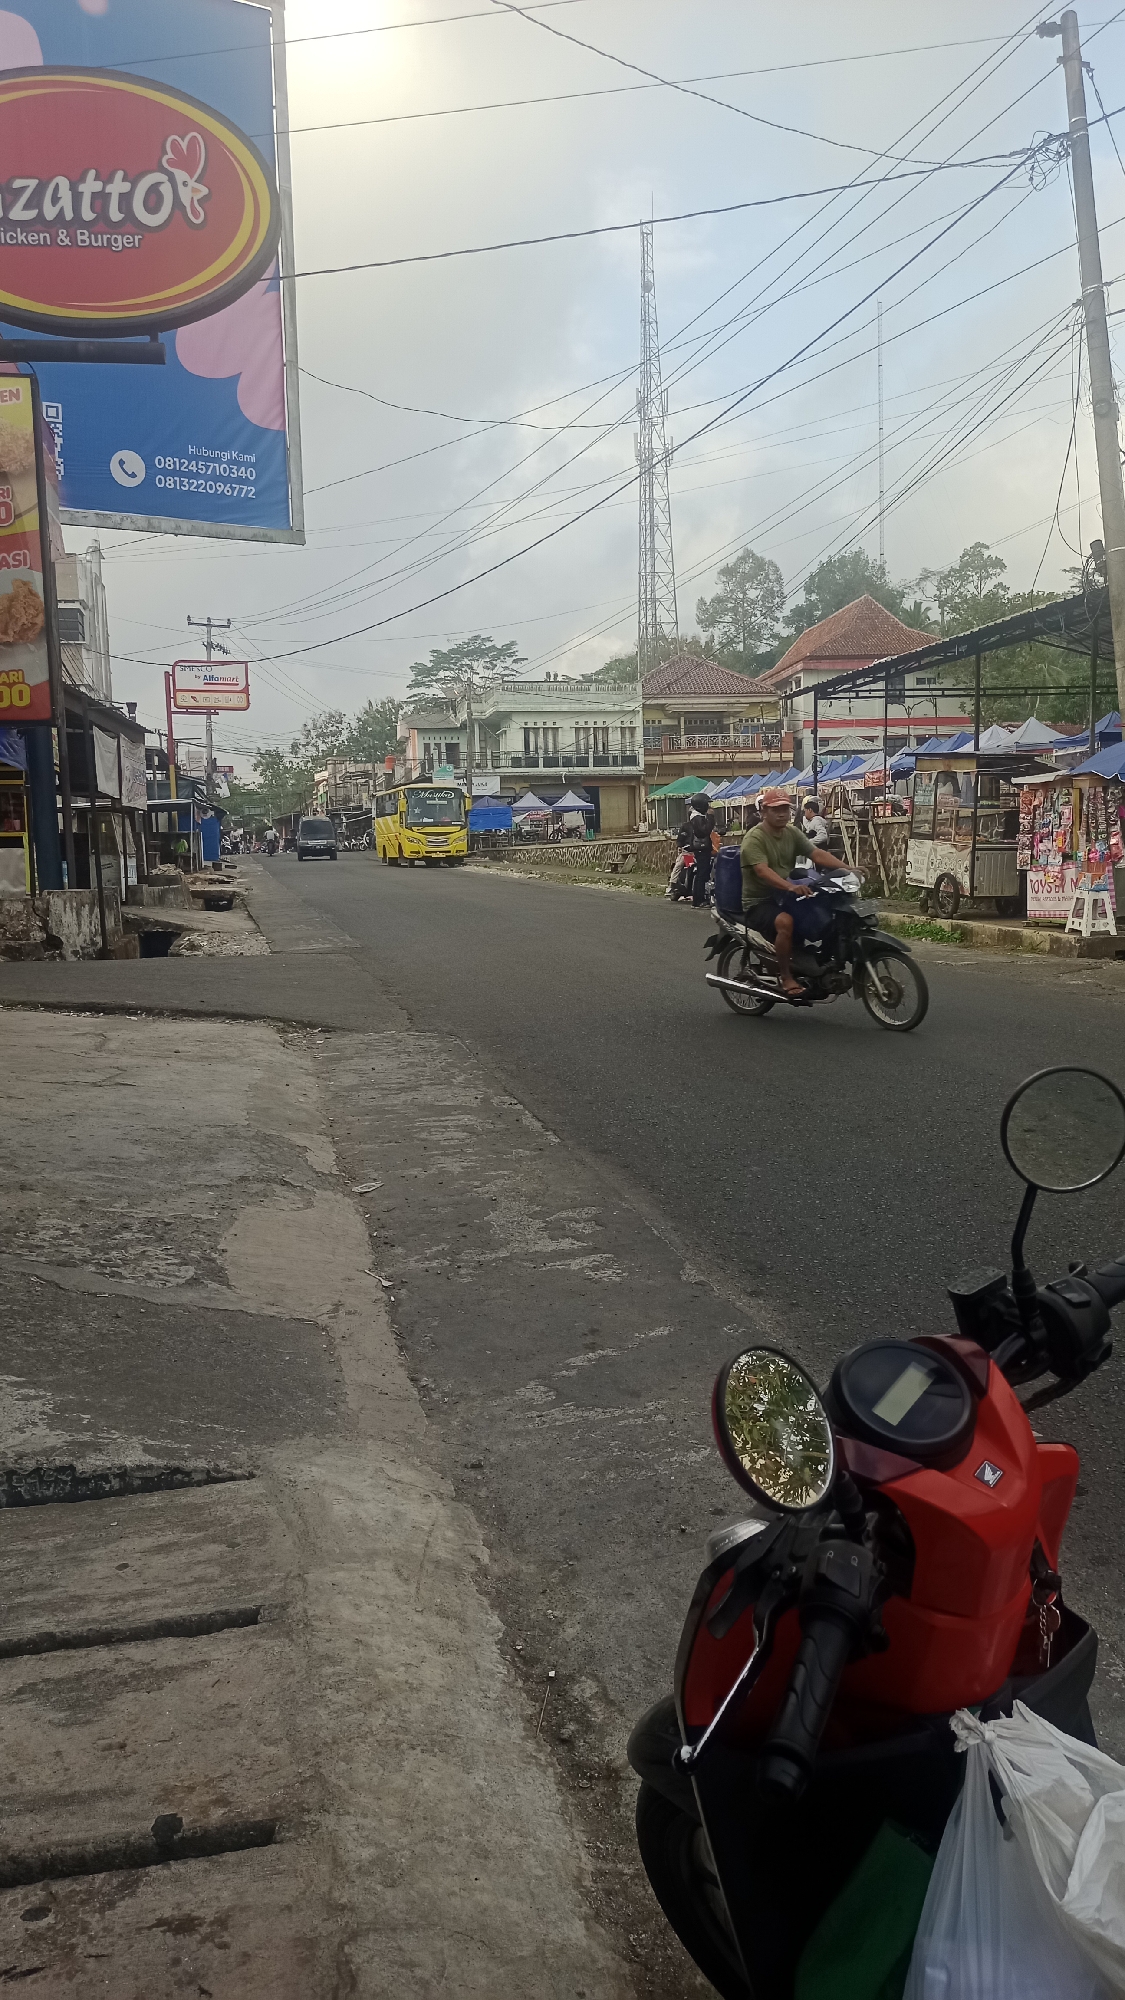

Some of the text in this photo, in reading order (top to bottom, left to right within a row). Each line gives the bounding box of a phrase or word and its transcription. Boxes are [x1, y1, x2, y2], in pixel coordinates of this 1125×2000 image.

[0, 169, 173, 227] zatto
[57, 229, 71, 246] &
[77, 229, 143, 252] Burger
[188, 445, 256, 463] Hubungi Kami
[155, 455, 256, 481] 081245710340
[155, 475, 256, 499] 081322096772
[203, 674, 240, 683] Alfamart
[1029, 878, 1053, 895] TOYS
